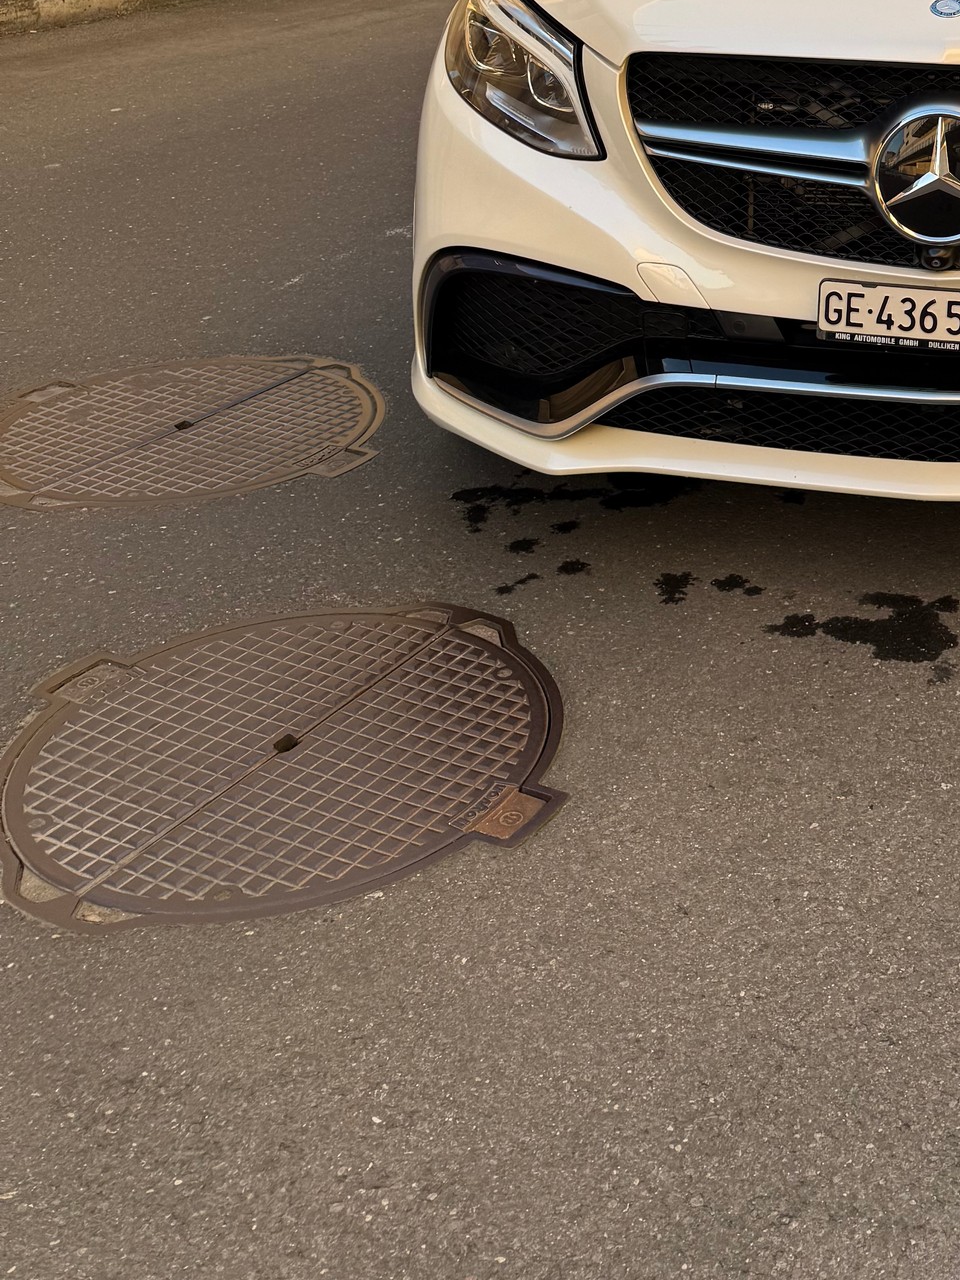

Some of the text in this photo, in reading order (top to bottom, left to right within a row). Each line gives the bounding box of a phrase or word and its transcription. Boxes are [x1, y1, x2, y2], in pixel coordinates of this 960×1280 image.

[835, 332, 919, 347] KING AUTOMOBILE GMBH
[928, 341, 959, 350] DULLIKEN
